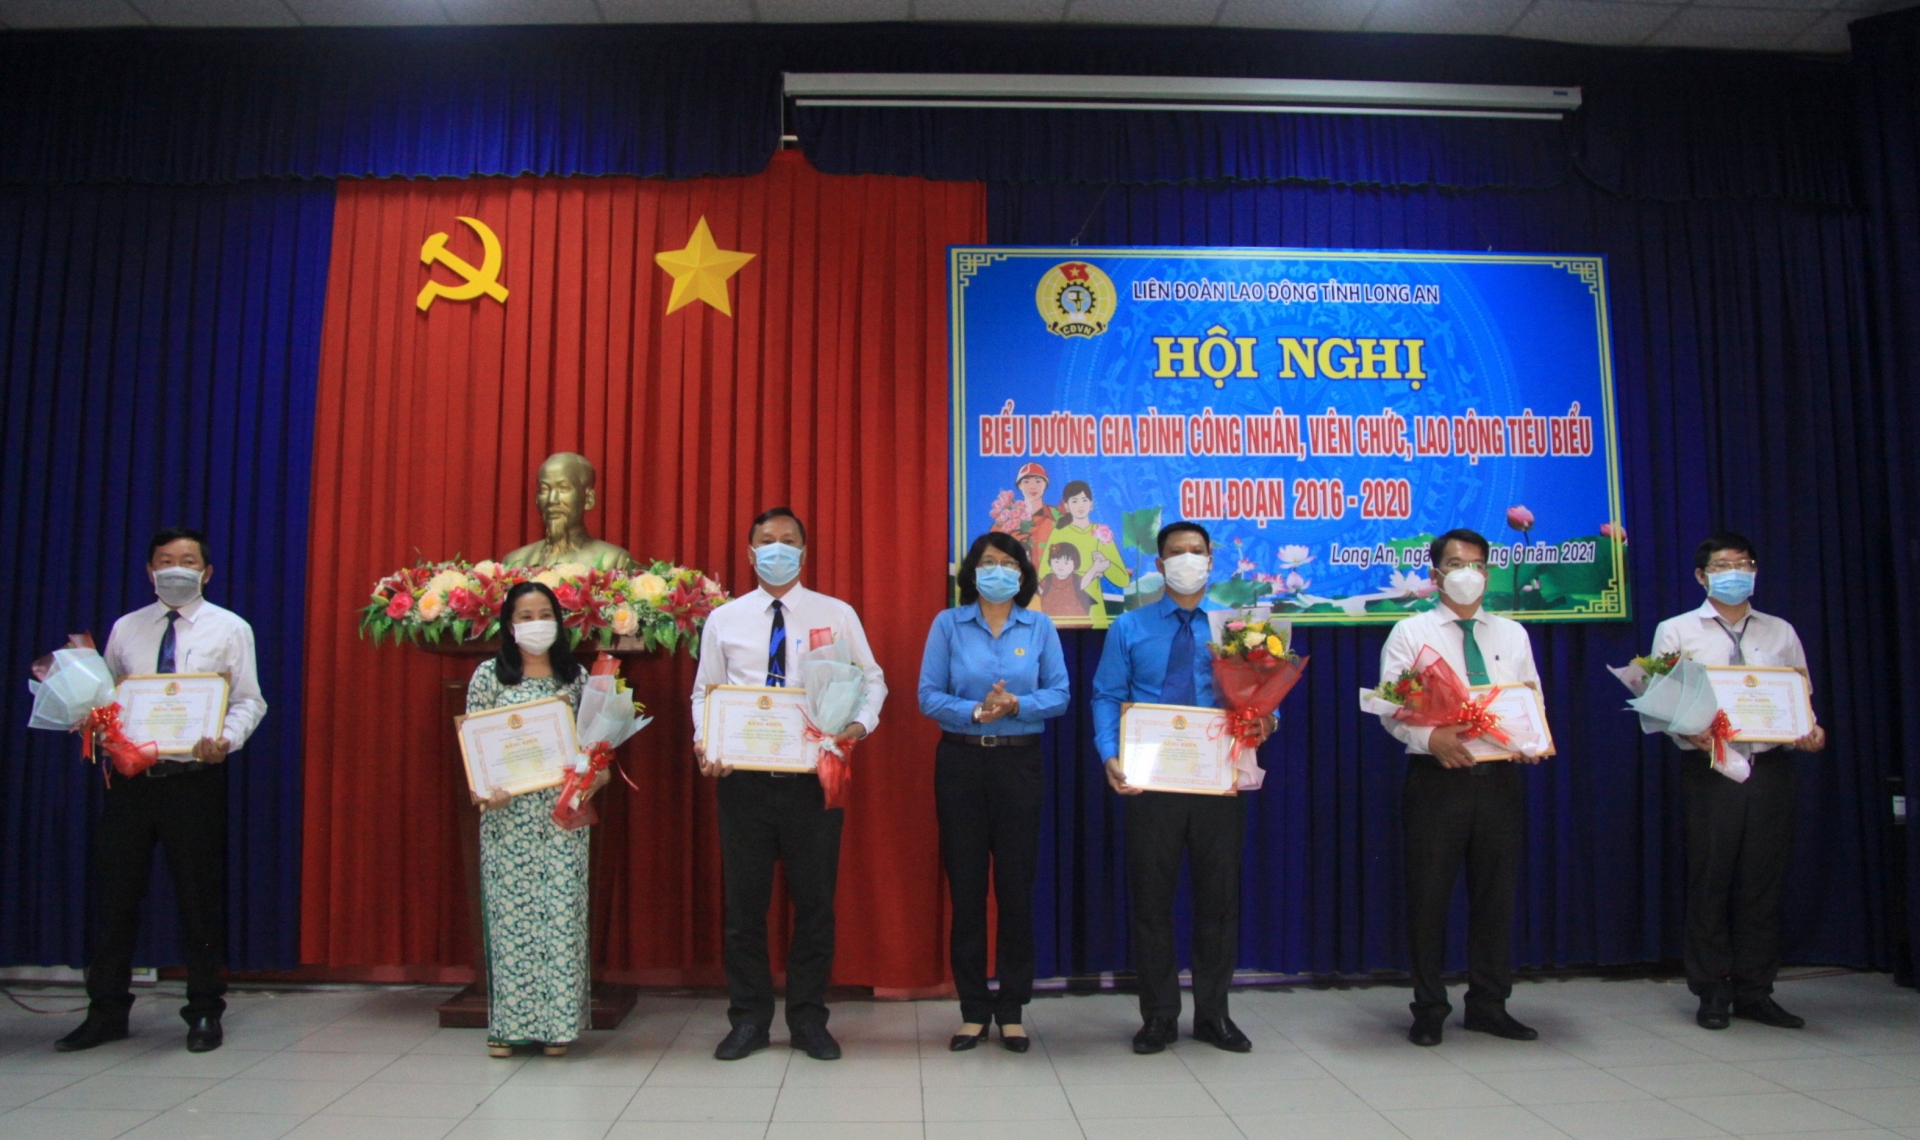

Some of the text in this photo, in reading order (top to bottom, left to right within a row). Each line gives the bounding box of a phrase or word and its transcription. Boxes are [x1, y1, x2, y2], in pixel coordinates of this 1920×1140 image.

[1133, 277, 1439, 304] LIÊN ĐOÀN LAO ĐỘNG TỈNH LONG AN
[1153, 325, 1427, 390] HỘI NGHỊ
[980, 399, 1592, 464] BIỂU DƯƠNG GIA ĐÌNH CÔNG NHÂN, VIÊN CHỨC, LAO ĐỘNG TIÊU BIỂU
[1181, 479, 1222, 519] GIAI
[1227, 479, 1283, 527] ĐOẠN
[1294, 479, 1343, 519] 2016
[1362, 479, 1410, 519] 2020
[1331, 544, 1369, 567] Long
[1373, 545, 1398, 567] An,
[1403, 542, 1432, 568] ngà
[1513, 543, 1523, 564] 6
[1526, 543, 1559, 564] năm
[1562, 542, 1595, 563] 2021
